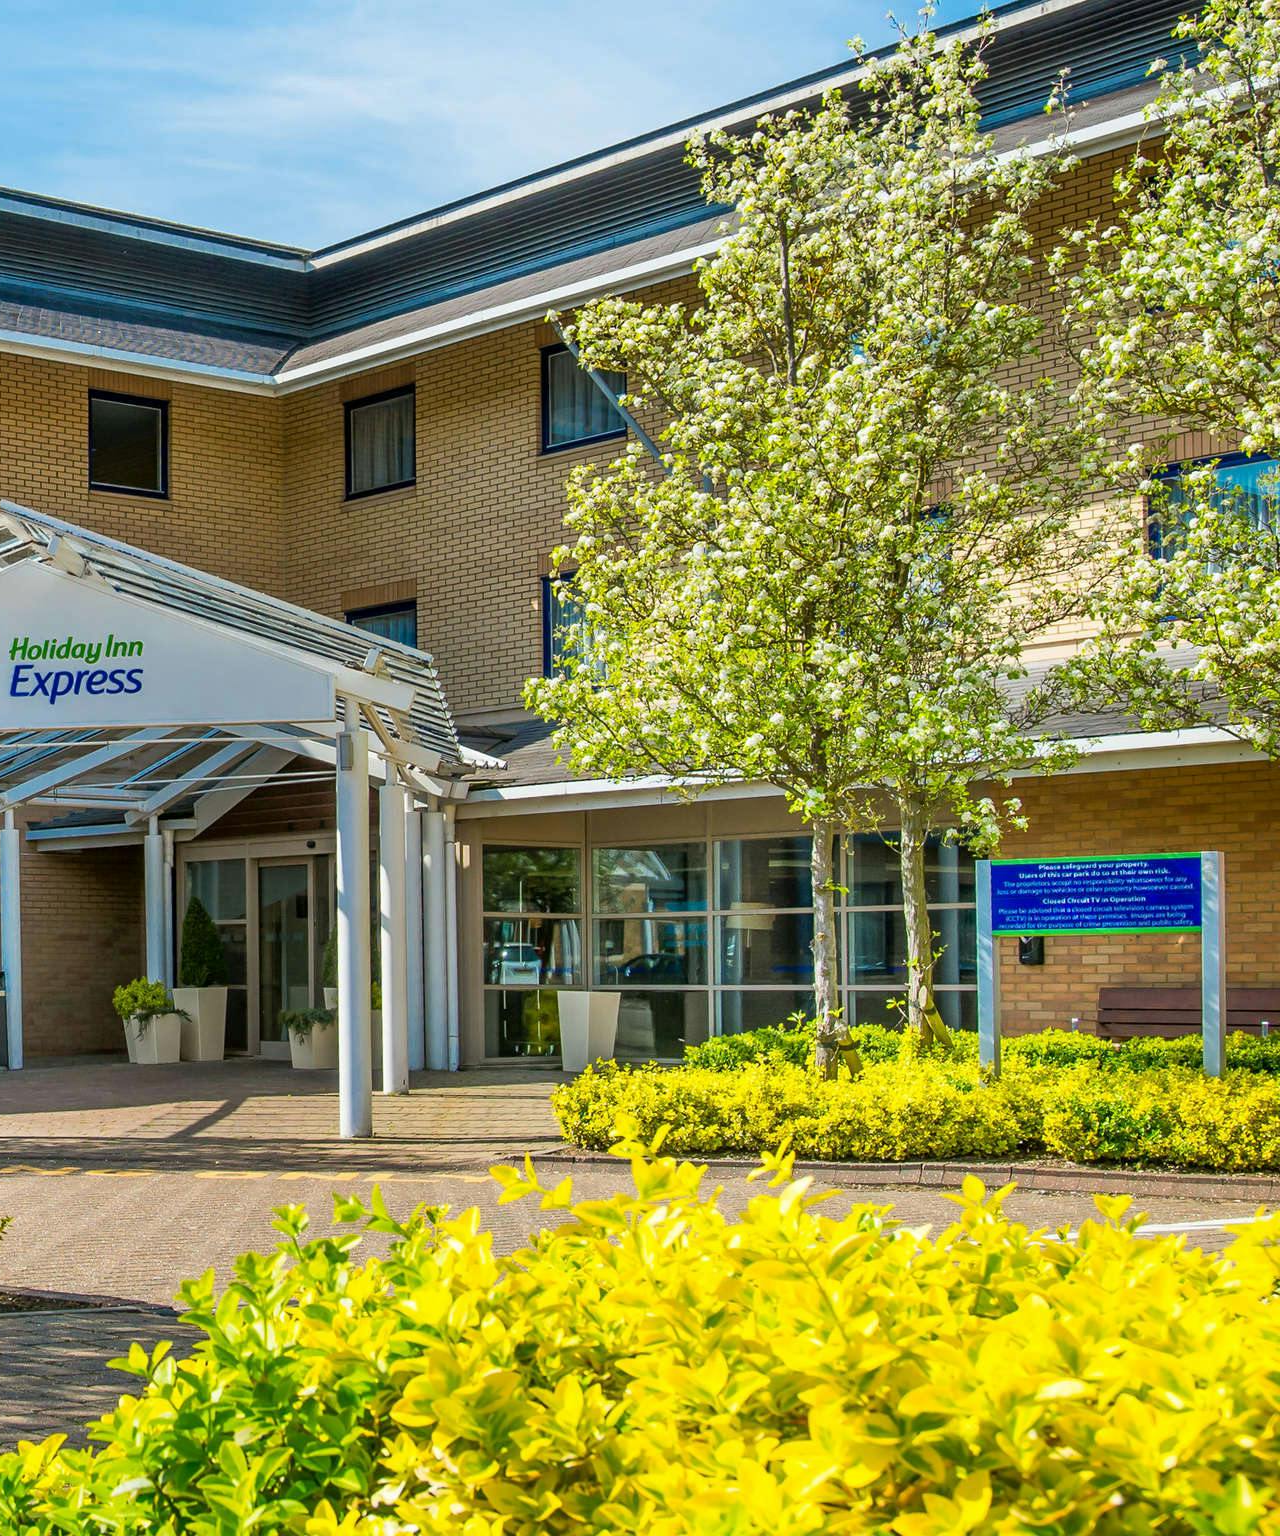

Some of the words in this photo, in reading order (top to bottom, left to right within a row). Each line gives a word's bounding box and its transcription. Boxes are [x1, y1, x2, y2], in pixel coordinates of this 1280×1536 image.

[9, 636, 101, 664] Holiday
[106, 634, 144, 659] Inn
[9, 664, 144, 705] Express
[193, 1170, 493, 1183] ONLY
